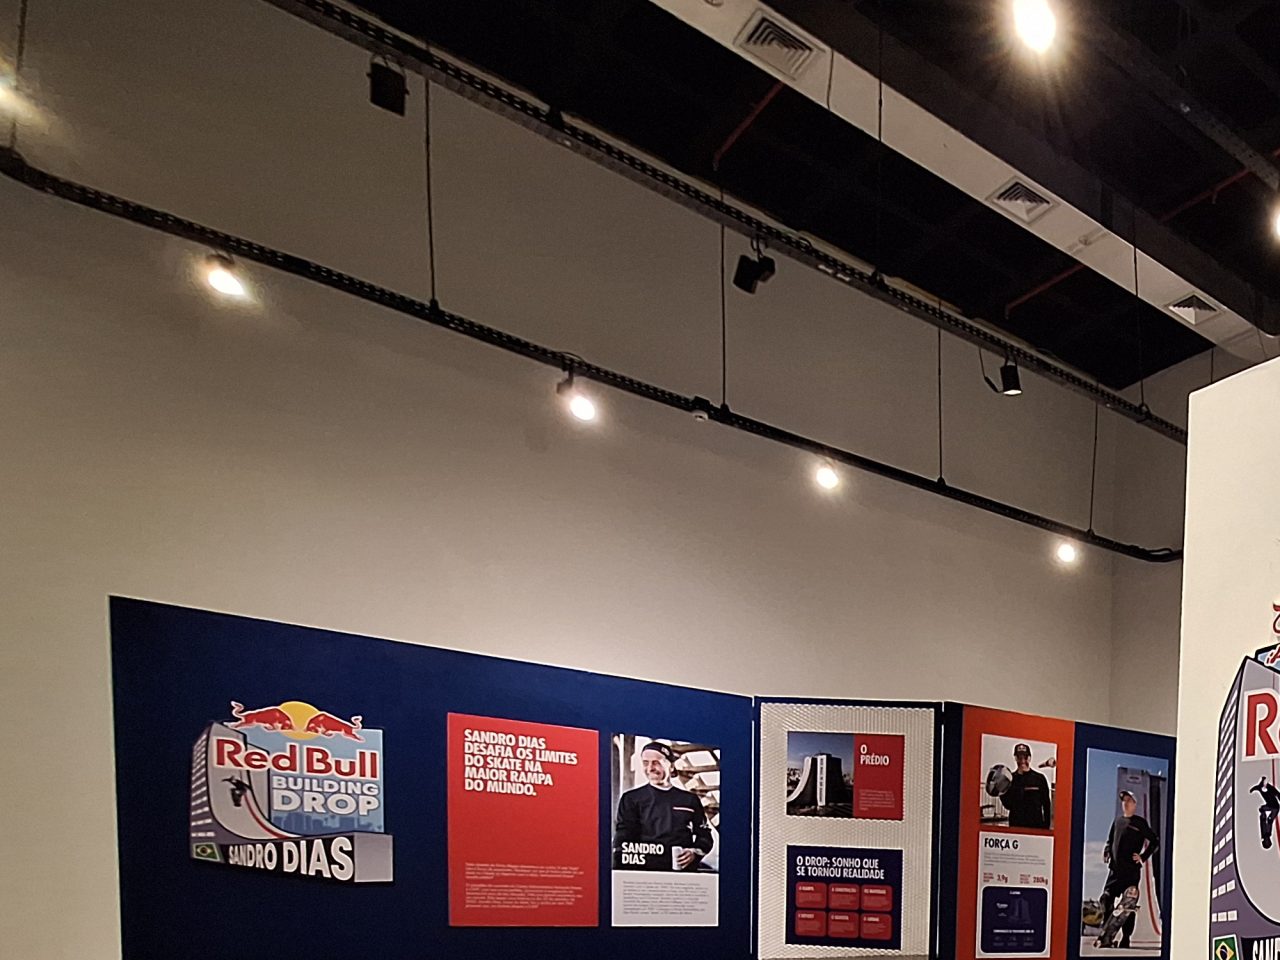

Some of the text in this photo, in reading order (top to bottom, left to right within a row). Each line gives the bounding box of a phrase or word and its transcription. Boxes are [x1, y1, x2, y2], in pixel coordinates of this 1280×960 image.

[464, 729, 546, 750] SANDRO DIAS
[215, 738, 377, 779] Red Bull
[464, 741, 578, 765] DESAFIA OS LIMITES
[860, 744, 868, 755] O
[464, 754, 543, 773] DO SKATE NA
[860, 752, 890, 766] PRÉDIO
[464, 766, 554, 786] MAIOR RAMPA
[272, 775, 379, 796] BUILDING
[464, 779, 538, 797] DO MUNDO.
[272, 789, 380, 816] DROP
[621, 841, 665, 855] SANDRO
[984, 837, 1019, 851] FORÇA G
[228, 836, 354, 881] SANDRO DIAS
[621, 853, 646, 866] DIAS
[796, 855, 880, 870] O DROP: SONHO QUE
[796, 866, 885, 880] SE TORNOU REALIDADE
